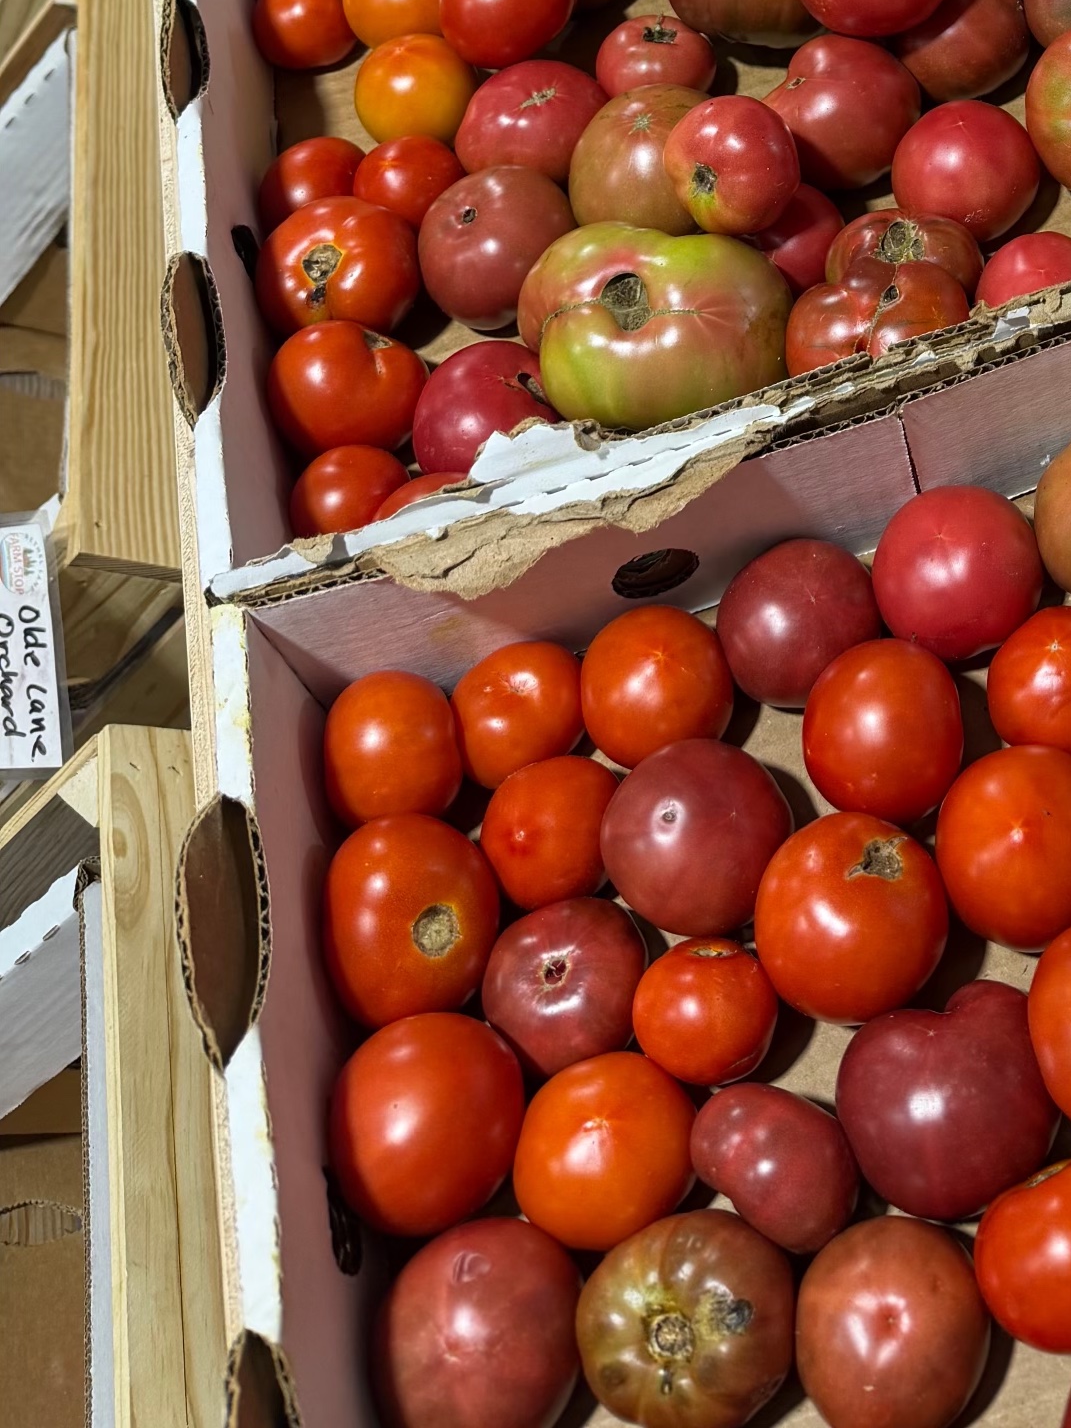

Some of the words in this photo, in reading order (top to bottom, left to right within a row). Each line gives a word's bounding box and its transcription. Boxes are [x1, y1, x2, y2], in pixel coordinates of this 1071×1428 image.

[9, 533, 23, 564] FARM
[13, 566, 25, 595] STOP
[18, 605, 48, 667] Olde
[0, 613, 26, 738] Orchard
[26, 686, 48, 759] Lane
